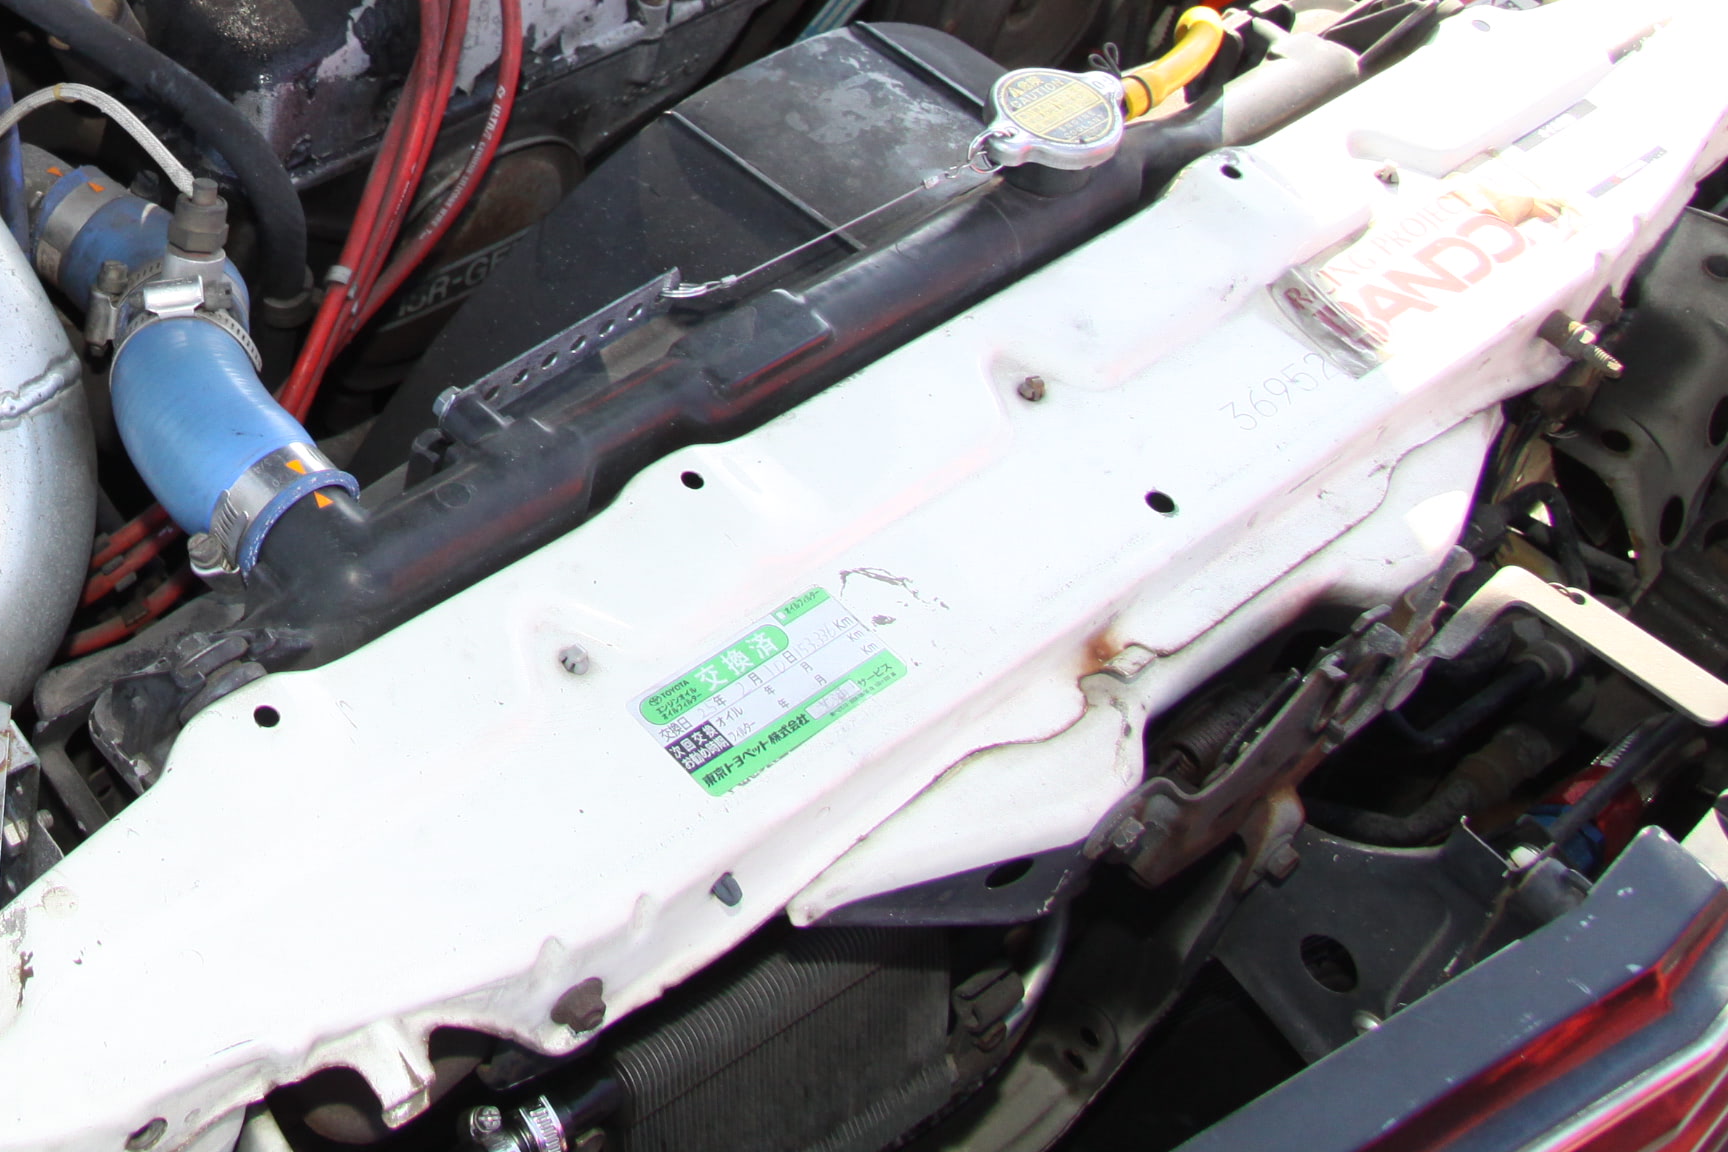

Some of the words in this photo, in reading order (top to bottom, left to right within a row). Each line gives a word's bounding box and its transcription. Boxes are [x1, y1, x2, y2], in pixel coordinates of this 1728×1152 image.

[1010, 78, 1064, 108] CAUTION
[1315, 213, 1536, 351] BANDO
[659, 717, 692, 739] 交換日
[713, 694, 728, 707] 年
[749, 672, 763, 685] 月
[783, 651, 797, 663] 日
[833, 615, 853, 631] Km
[662, 680, 689, 699] TOYOTA
[695, 632, 777, 690] 交換済
[715, 705, 744, 727] オイル
[764, 685, 776, 695] 年
[801, 662, 813, 672] 月
[848, 629, 864, 642] Km
[729, 721, 757, 741] フィルター
[778, 698, 790, 709] 年
[815, 675, 827, 685] 月
[861, 642, 878, 655] Km
[670, 724, 718, 758] 次回交換
[702, 712, 809, 787] 東京トヨペット株式会社
[858, 662, 891, 687] サービス
